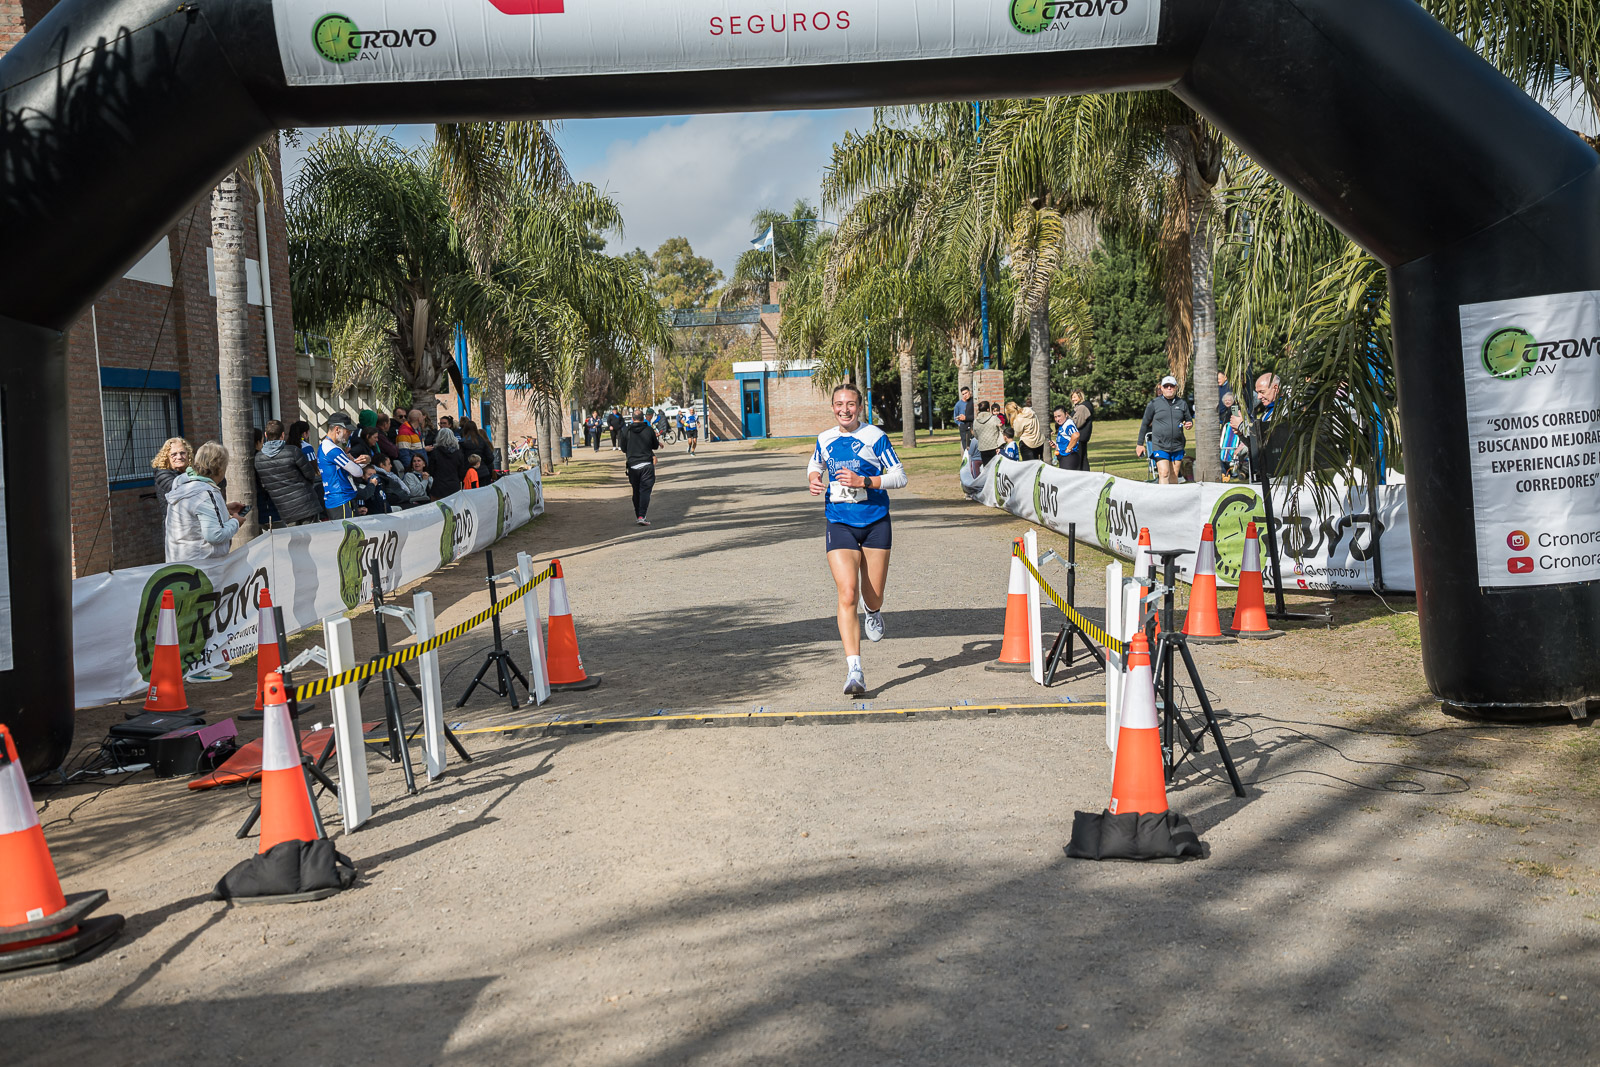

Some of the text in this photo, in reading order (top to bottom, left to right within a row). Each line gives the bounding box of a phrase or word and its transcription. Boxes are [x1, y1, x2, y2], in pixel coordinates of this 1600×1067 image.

[1042, 0, 1128, 19] CRONO
[709, 10, 850, 36] SEGUROS
[1039, 21, 1070, 32] RAV
[348, 28, 437, 49] CRONO
[348, 51, 380, 62] RAV
[1521, 364, 1557, 377] RAV
[1487, 415, 1539, 432] “SOMOS
[1478, 435, 1548, 453] BUSCANDO
[1492, 452, 1596, 473] EXPERIENCIAS DE
[1516, 473, 1599, 493] CORREDORES”
